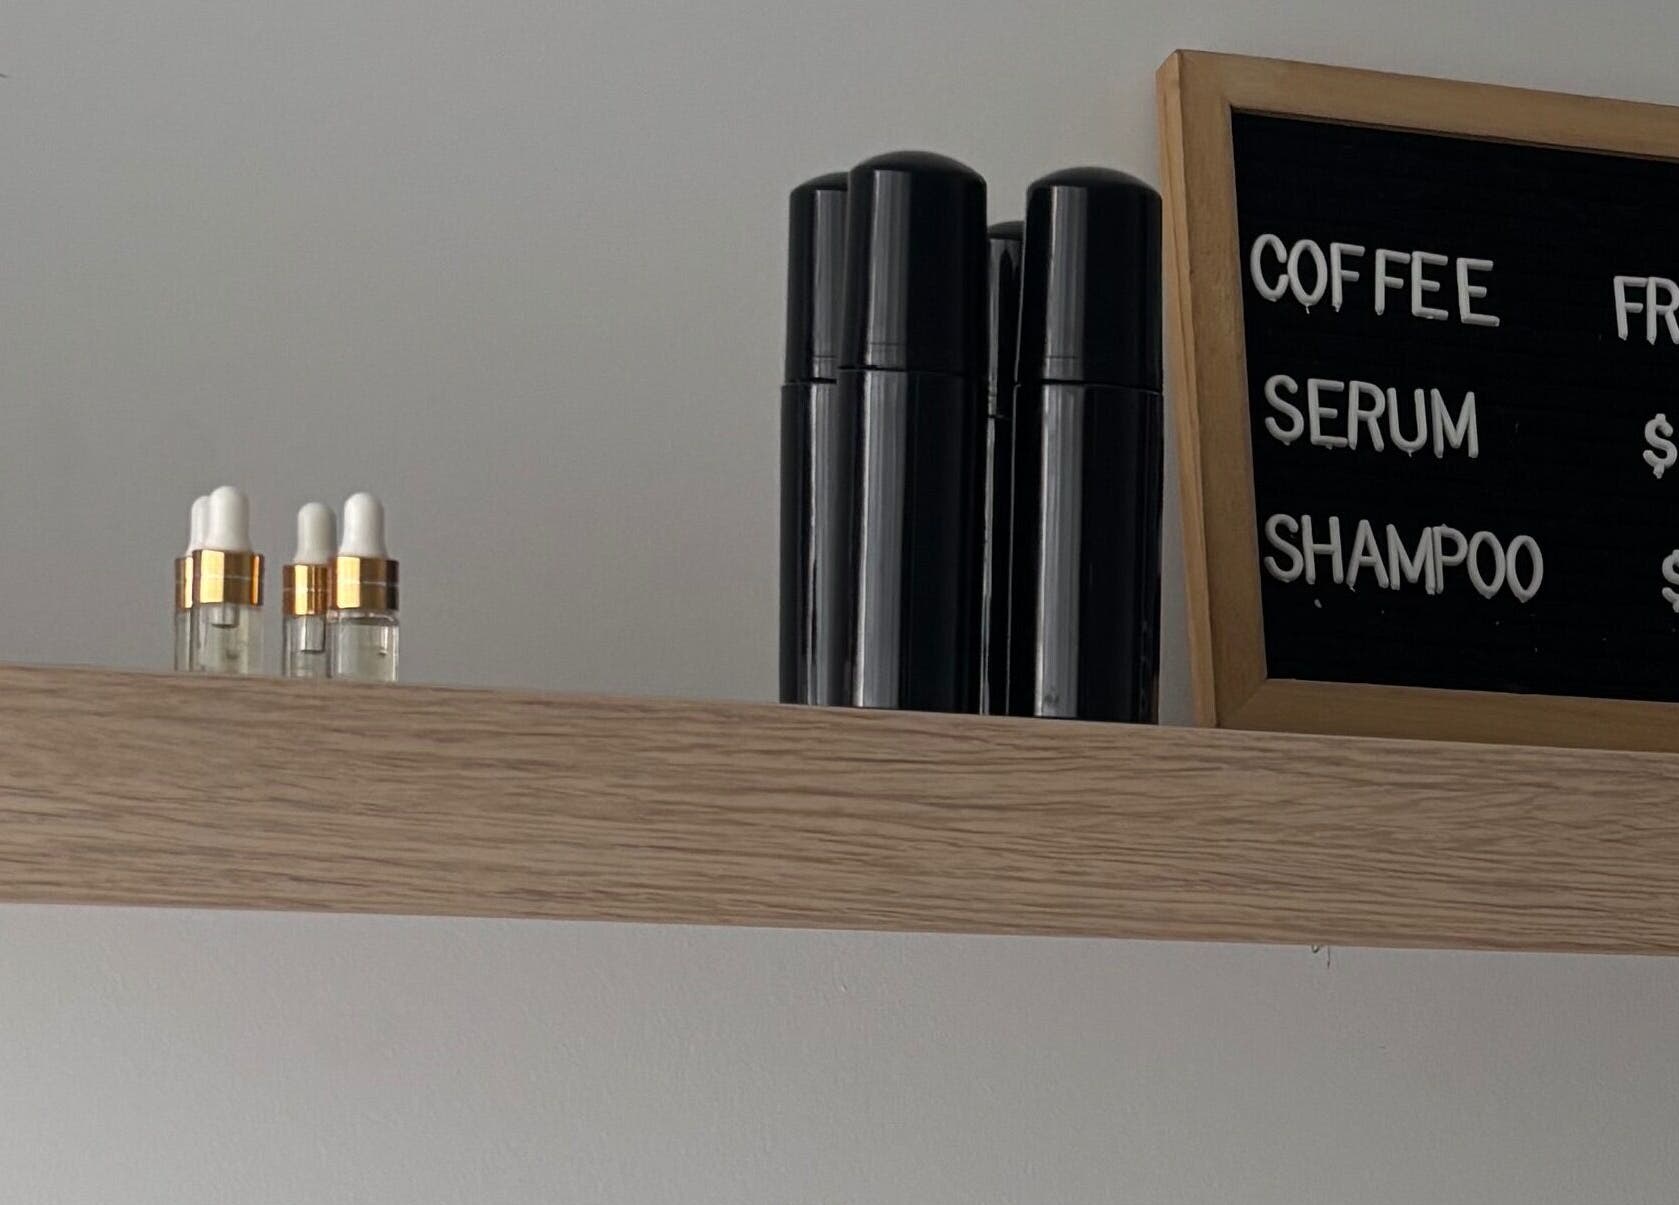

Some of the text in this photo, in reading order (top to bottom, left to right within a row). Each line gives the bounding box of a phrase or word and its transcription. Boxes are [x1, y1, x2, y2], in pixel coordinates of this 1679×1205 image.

[1250, 233, 1500, 327] COFFEE
[1264, 374, 1479, 459] SERUM
[1264, 513, 1544, 602] SHAMPOO
